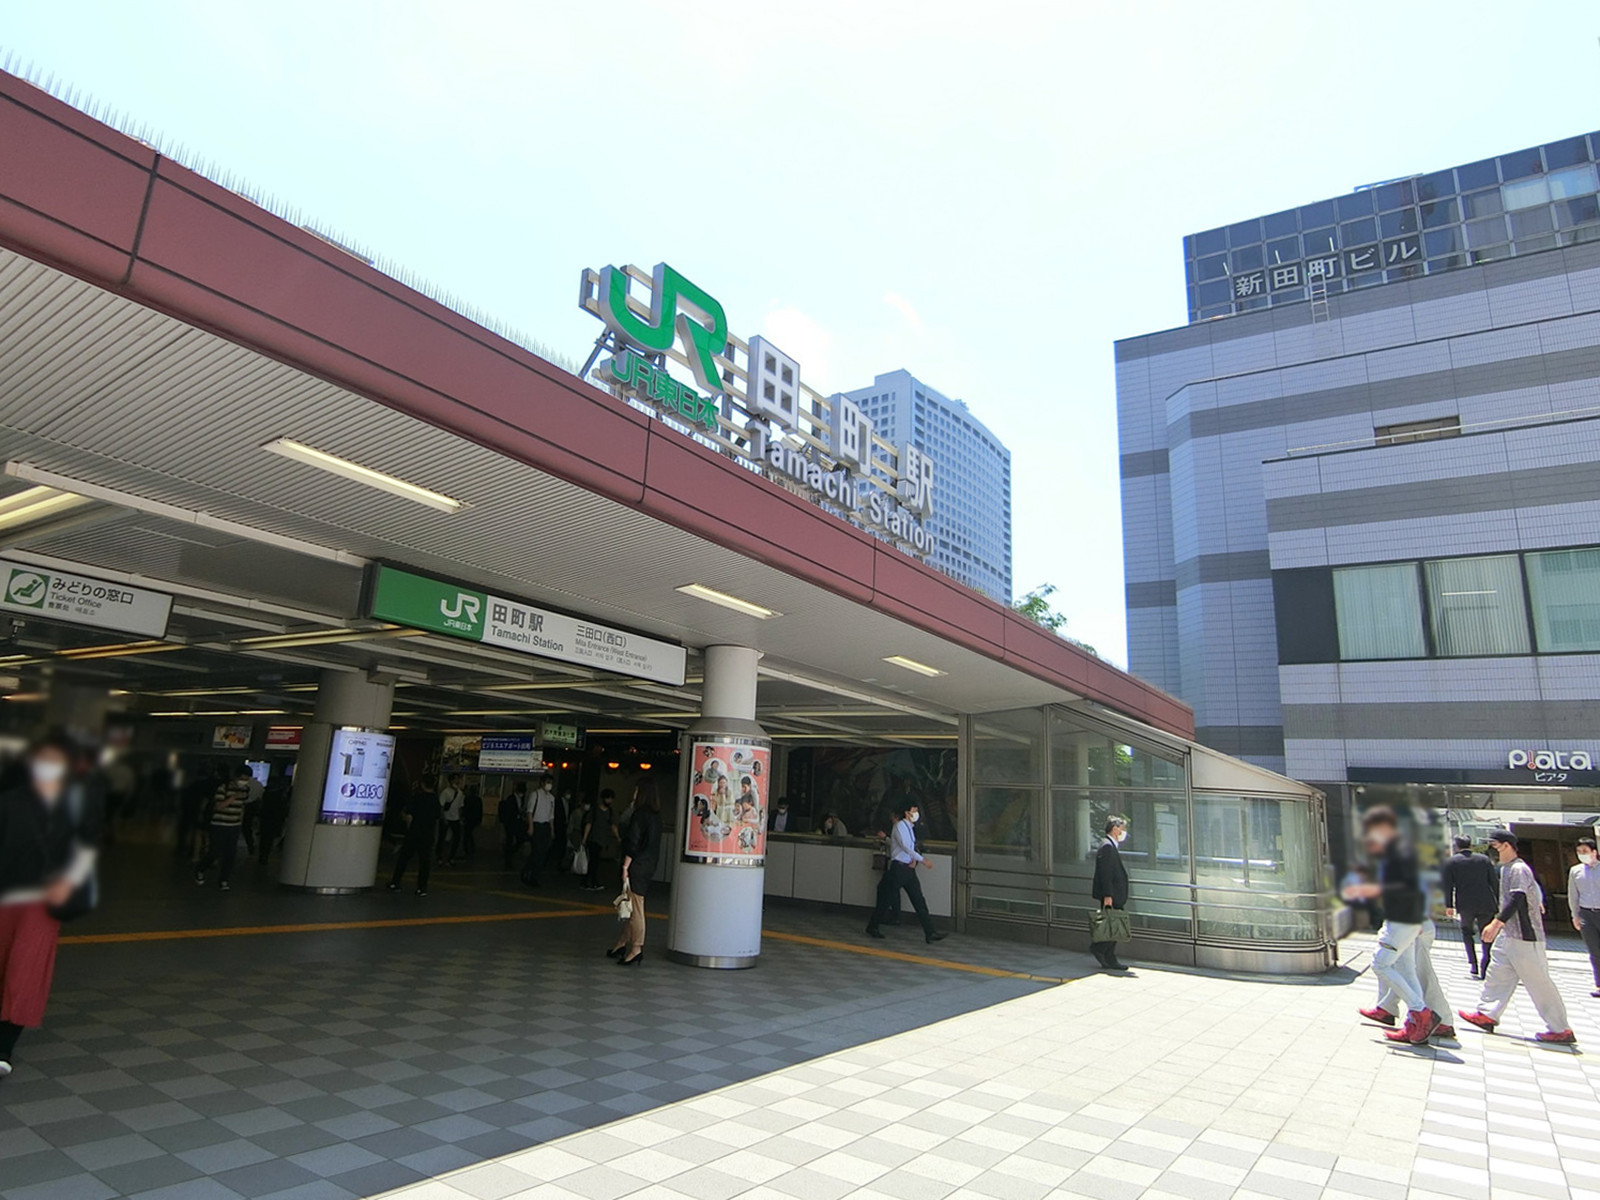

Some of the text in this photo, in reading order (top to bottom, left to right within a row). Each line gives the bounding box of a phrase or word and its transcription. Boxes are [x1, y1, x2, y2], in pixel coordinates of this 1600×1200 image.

[1236, 241, 1417, 297] 新田町ビル
[602, 262, 728, 395] JR
[606, 350, 719, 432] JR東日本
[748, 335, 935, 518] 田町駅
[748, 418, 935, 556] Tamachi Station
[50, 592, 102, 609] Ticket Office
[52, 577, 134, 605] みどりの窓口
[440, 592, 480, 624] JR
[492, 603, 544, 633] 田町駅
[443, 619, 473, 632] JR東日本
[491, 625, 564, 652] Tamachi Station
[576, 624, 627, 648] 三田口(西口)
[575, 638, 587, 648] Mita
[587, 640, 610, 653] Entrance
[356, 783, 384, 799] RISO
